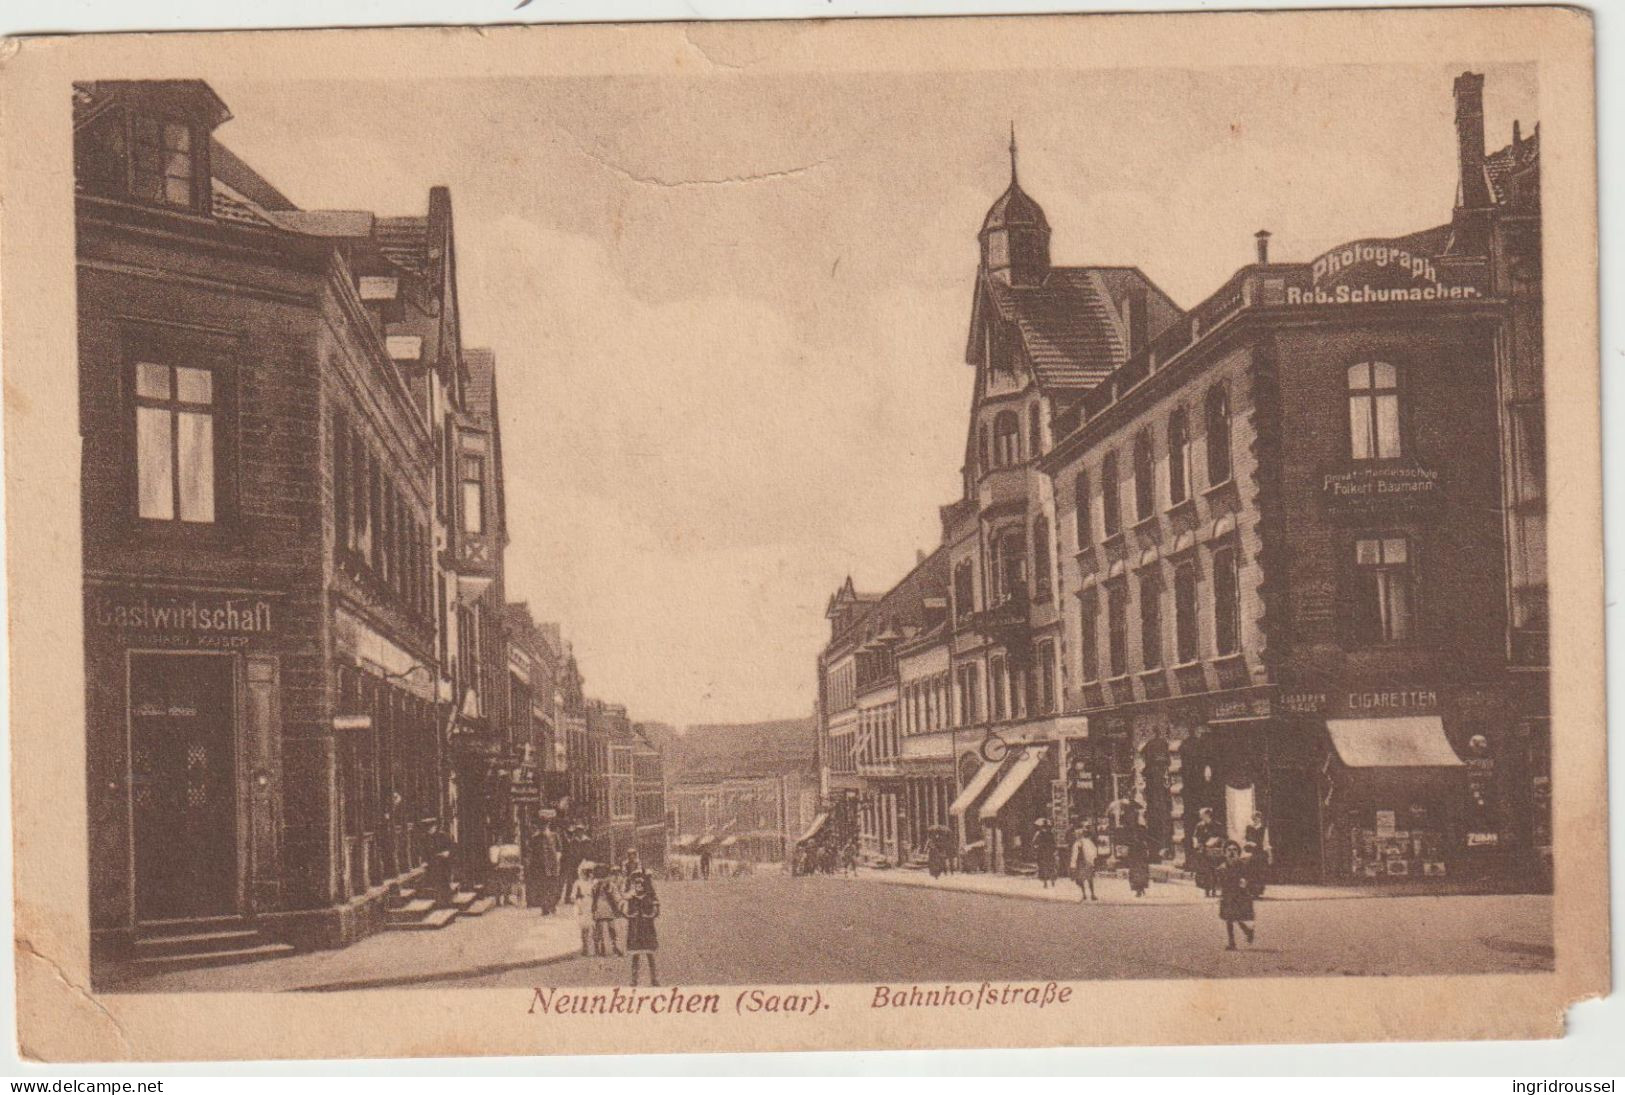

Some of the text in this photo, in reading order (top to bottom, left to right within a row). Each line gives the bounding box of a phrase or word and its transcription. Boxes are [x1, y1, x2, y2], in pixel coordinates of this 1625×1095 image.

[1312, 244, 1436, 286] Photograph
[96, 598, 271, 632] Gastwirtschaft
[1348, 691, 1438, 709] CIGARETTEN
